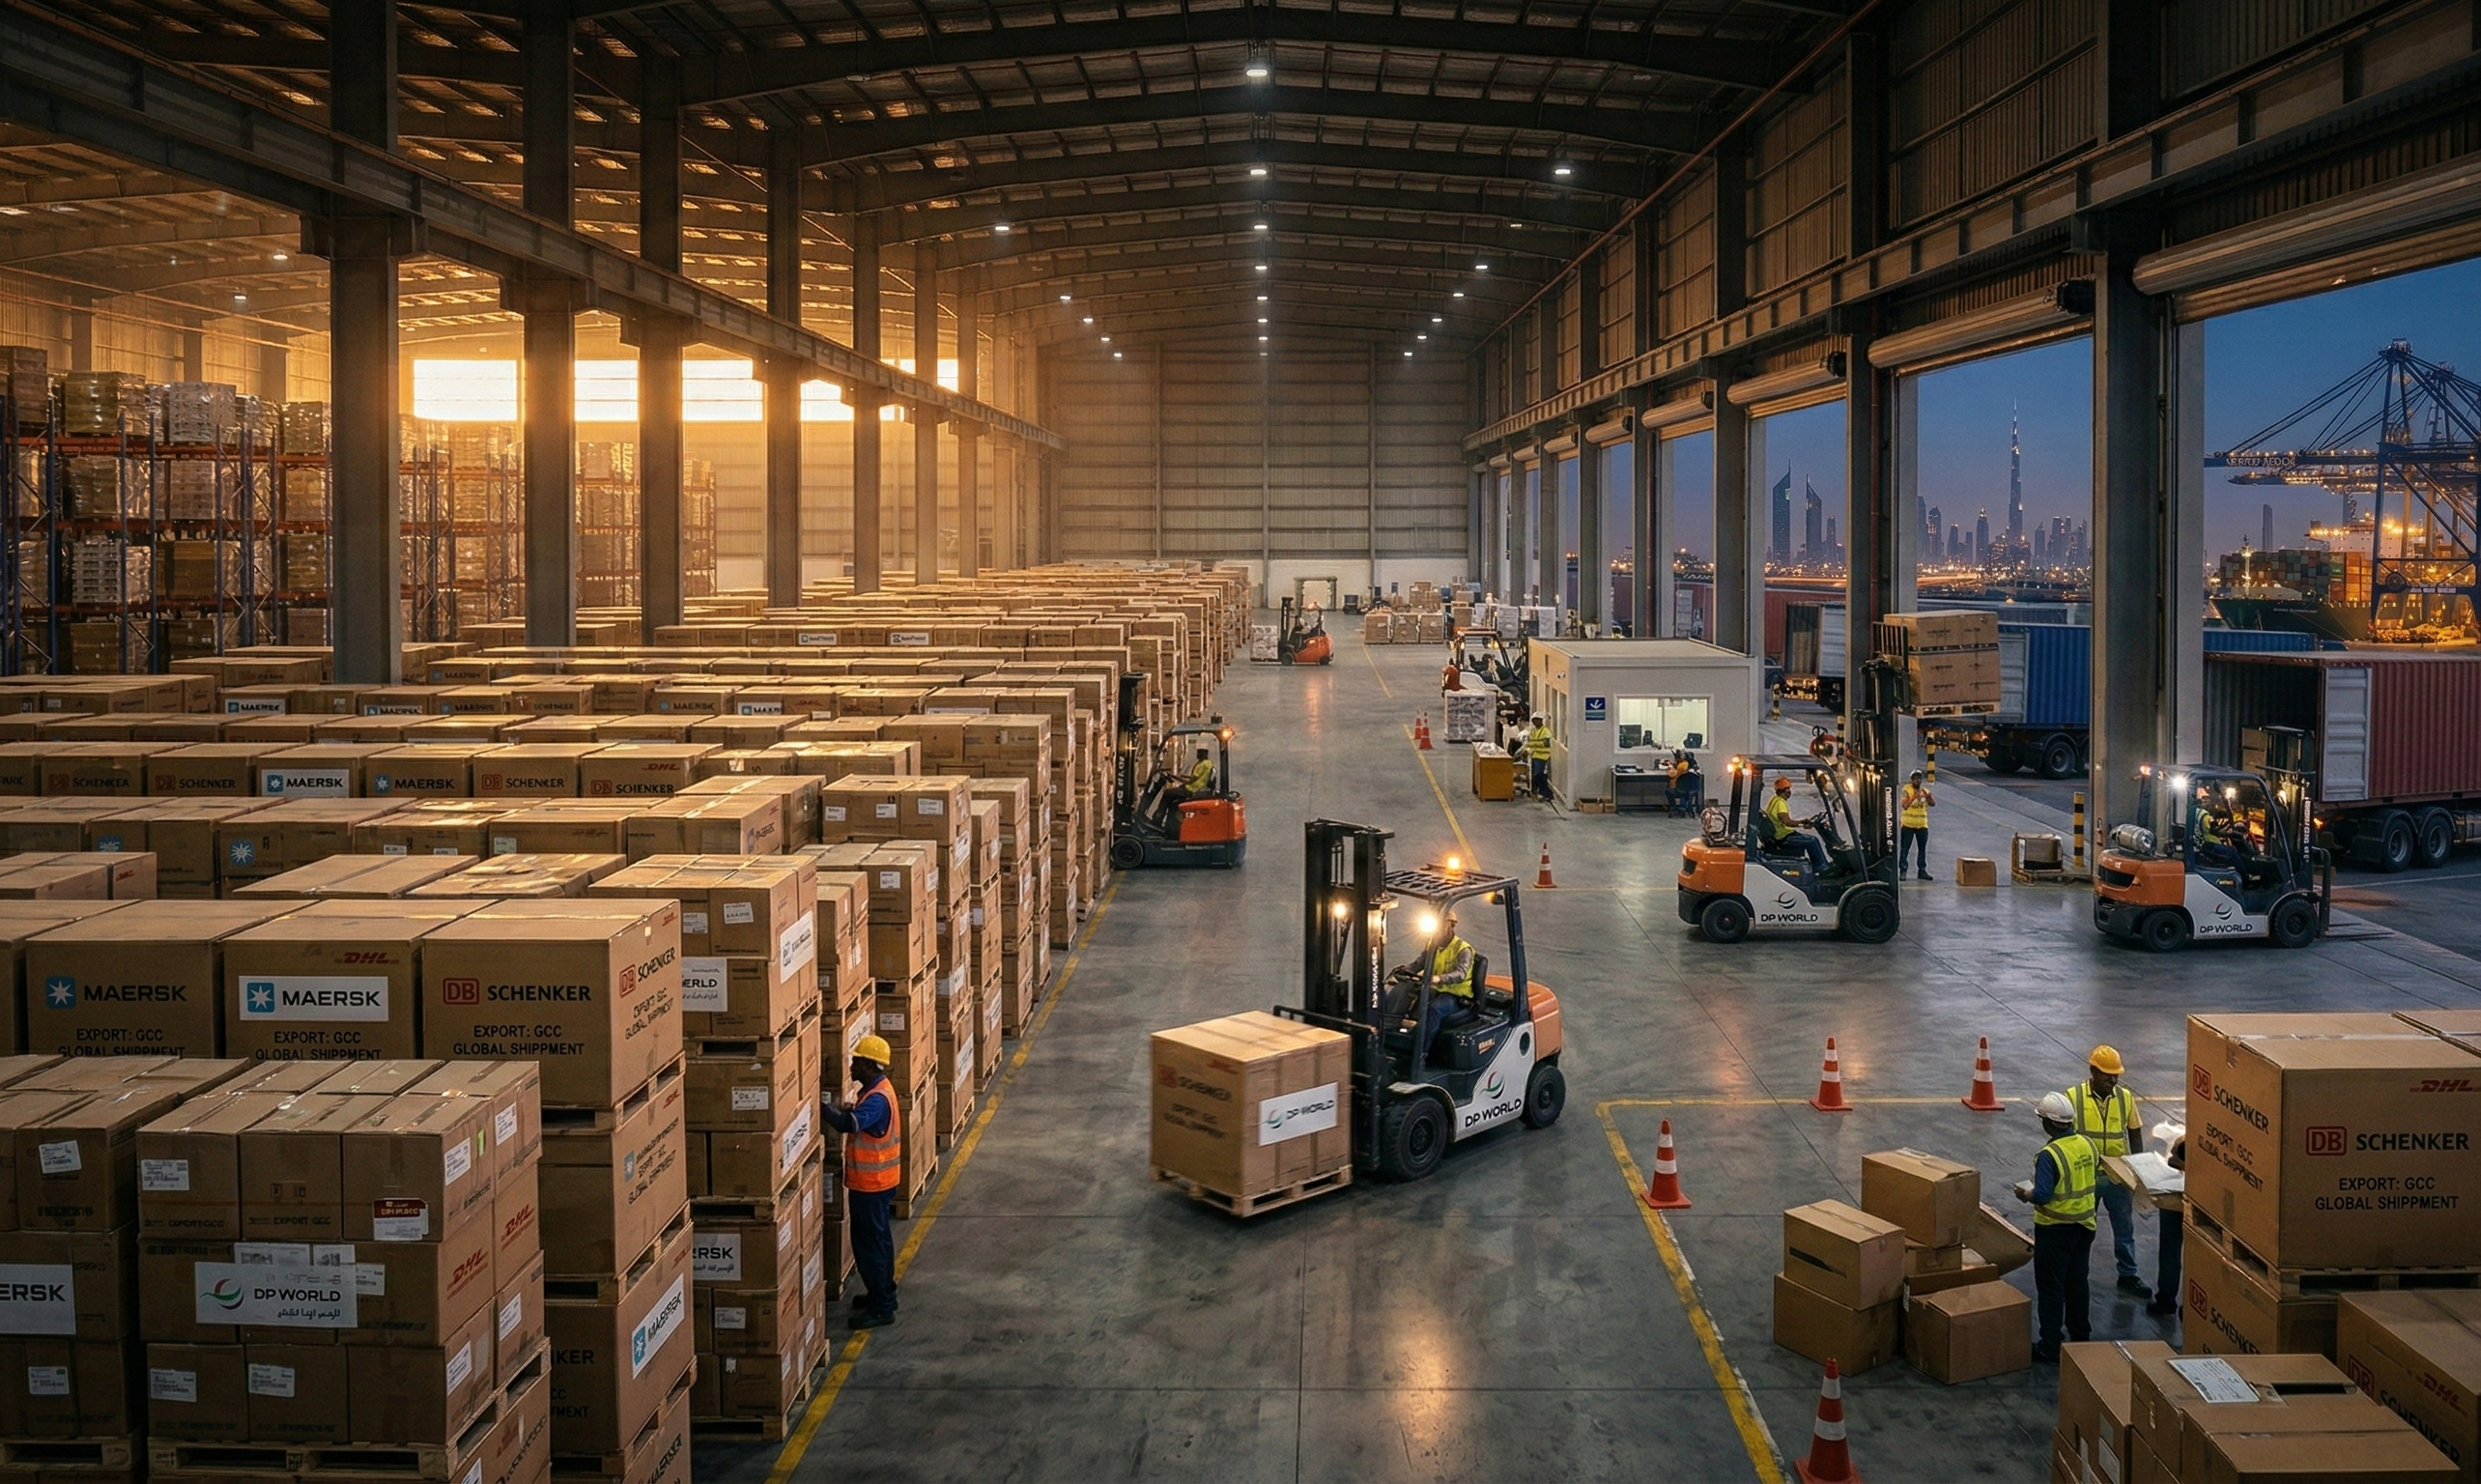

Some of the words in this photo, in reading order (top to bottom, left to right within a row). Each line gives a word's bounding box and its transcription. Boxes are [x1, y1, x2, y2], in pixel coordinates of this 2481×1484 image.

[286, 778, 343, 787] MAERSK
[395, 778, 456, 789] MAERSK
[1760, 913, 1776, 922] DP
[1778, 913, 1818, 922] WORLD
[2199, 925, 2213, 933] DP
[2214, 923, 2253, 933] WORLD
[342, 952, 391, 964] DHL
[84, 985, 187, 1002] MAERSK
[282, 990, 381, 1007] MAERSK
[445, 982, 476, 1002] DB
[487, 985, 591, 1002] SCHENKER
[76, 1028, 132, 1042] EXPORT:
[135, 1028, 163, 1042] GCC
[273, 1031, 330, 1043] EXPORT:
[333, 1031, 361, 1043] GCC
[473, 1025, 530, 1038] EXPORT:
[533, 1025, 562, 1038] GCC
[309, 1047, 383, 1061] SHIPPMENT
[453, 1042, 506, 1056] GLOBAL
[510, 1042, 585, 1056] SHIPPMENT
[2420, 1079, 2473, 1093] DHL
[1465, 1112, 1481, 1127] DP
[1482, 1099, 1523, 1121] WORLD
[2213, 1084, 2269, 1135] SCHENKER
[2310, 1130, 2344, 1153] DB
[2355, 1132, 2469, 1152] SCHENKER
[2339, 1177, 2400, 1191] EXPORT:
[2405, 1177, 2436, 1190] GCC
[2315, 1196, 2374, 1211] GLOBAL
[2378, 1195, 2459, 1210] SHIPPMENT
[453, 1248, 484, 1284] DHL
[254, 1288, 276, 1300] DP
[278, 1289, 341, 1302] WORLD
